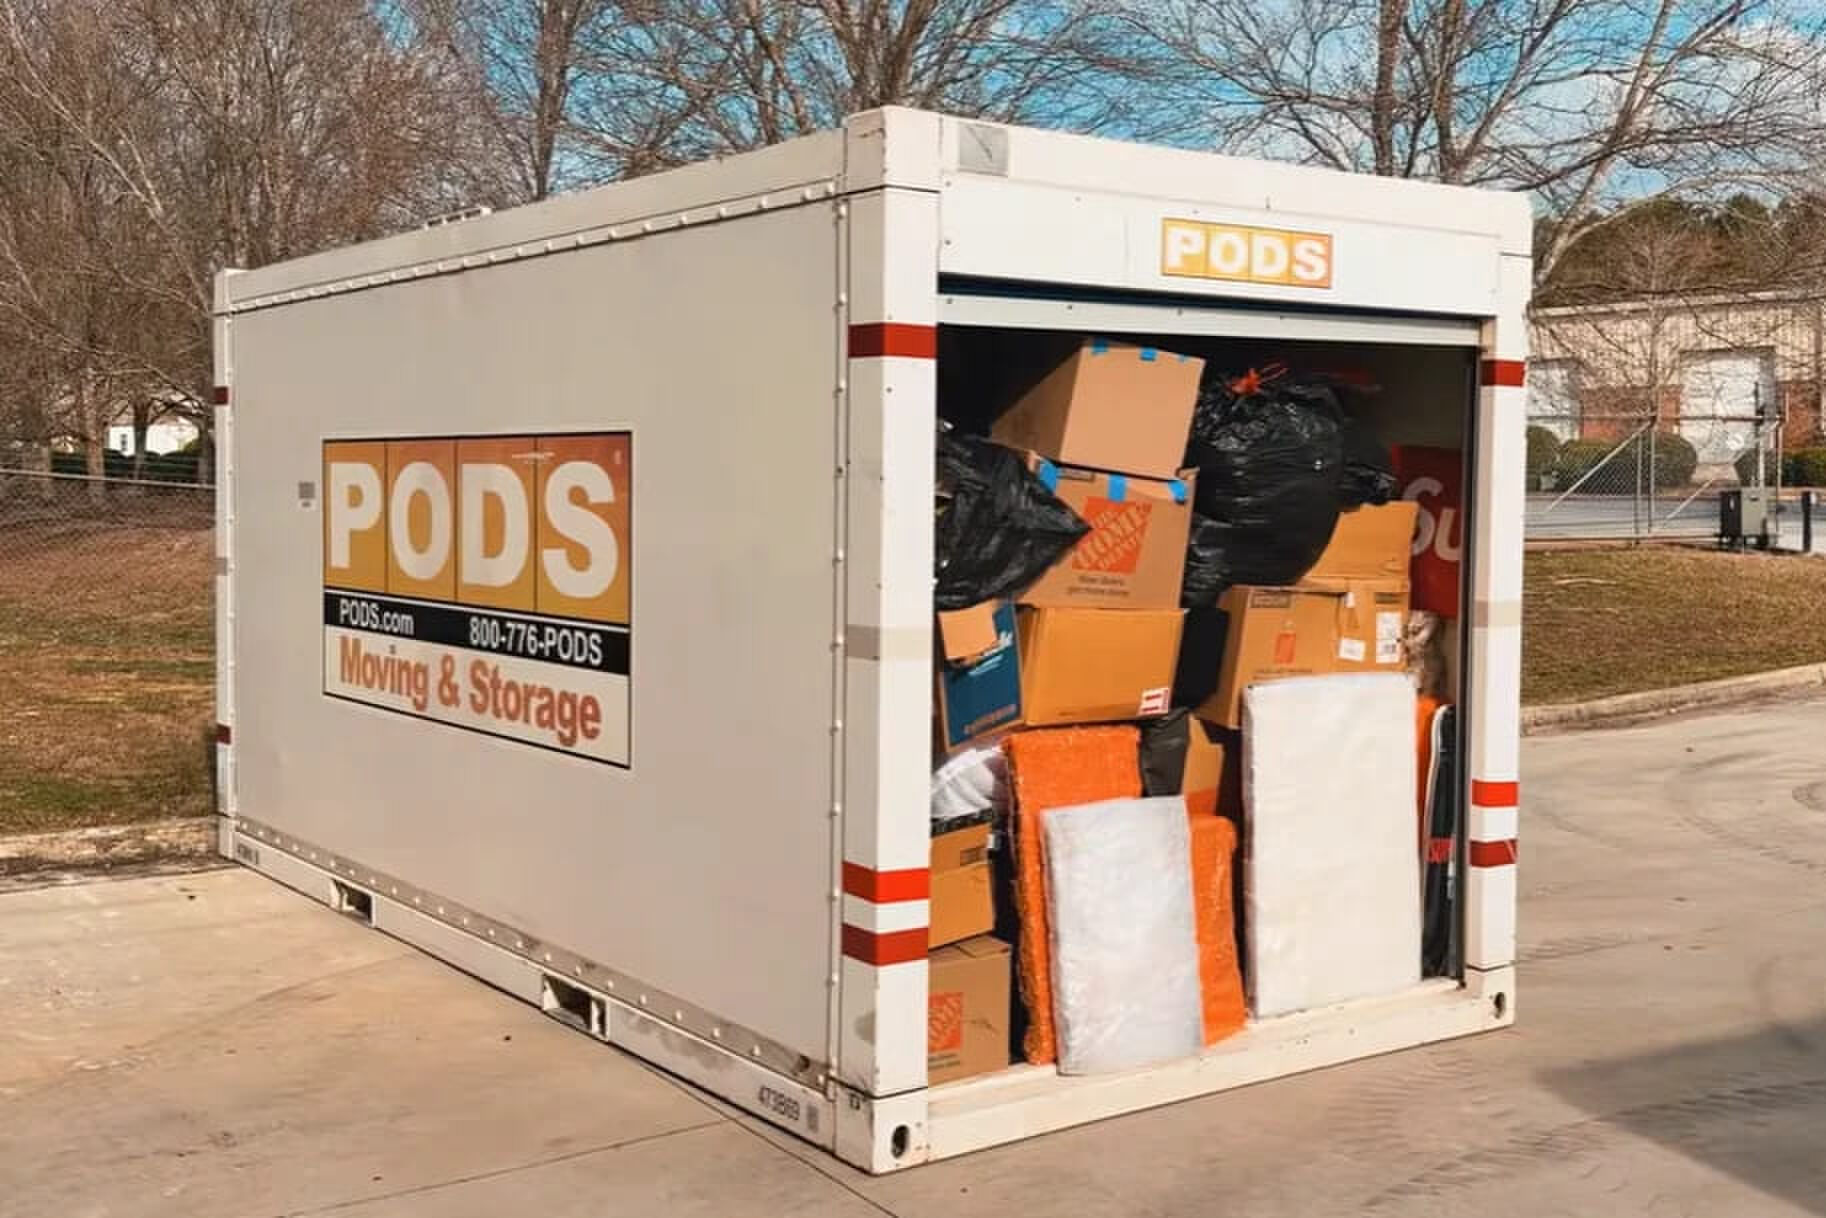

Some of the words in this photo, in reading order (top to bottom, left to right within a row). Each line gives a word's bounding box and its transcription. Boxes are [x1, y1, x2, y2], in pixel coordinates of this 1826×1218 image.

[1167, 227, 1327, 281] PODS
[329, 461, 620, 599] PODS
[339, 600, 415, 636] PODS.com
[469, 616, 602, 666] 800-776-PODS
[339, 636, 429, 711] Moving
[437, 653, 461, 708] &
[469, 659, 602, 747] Storage
